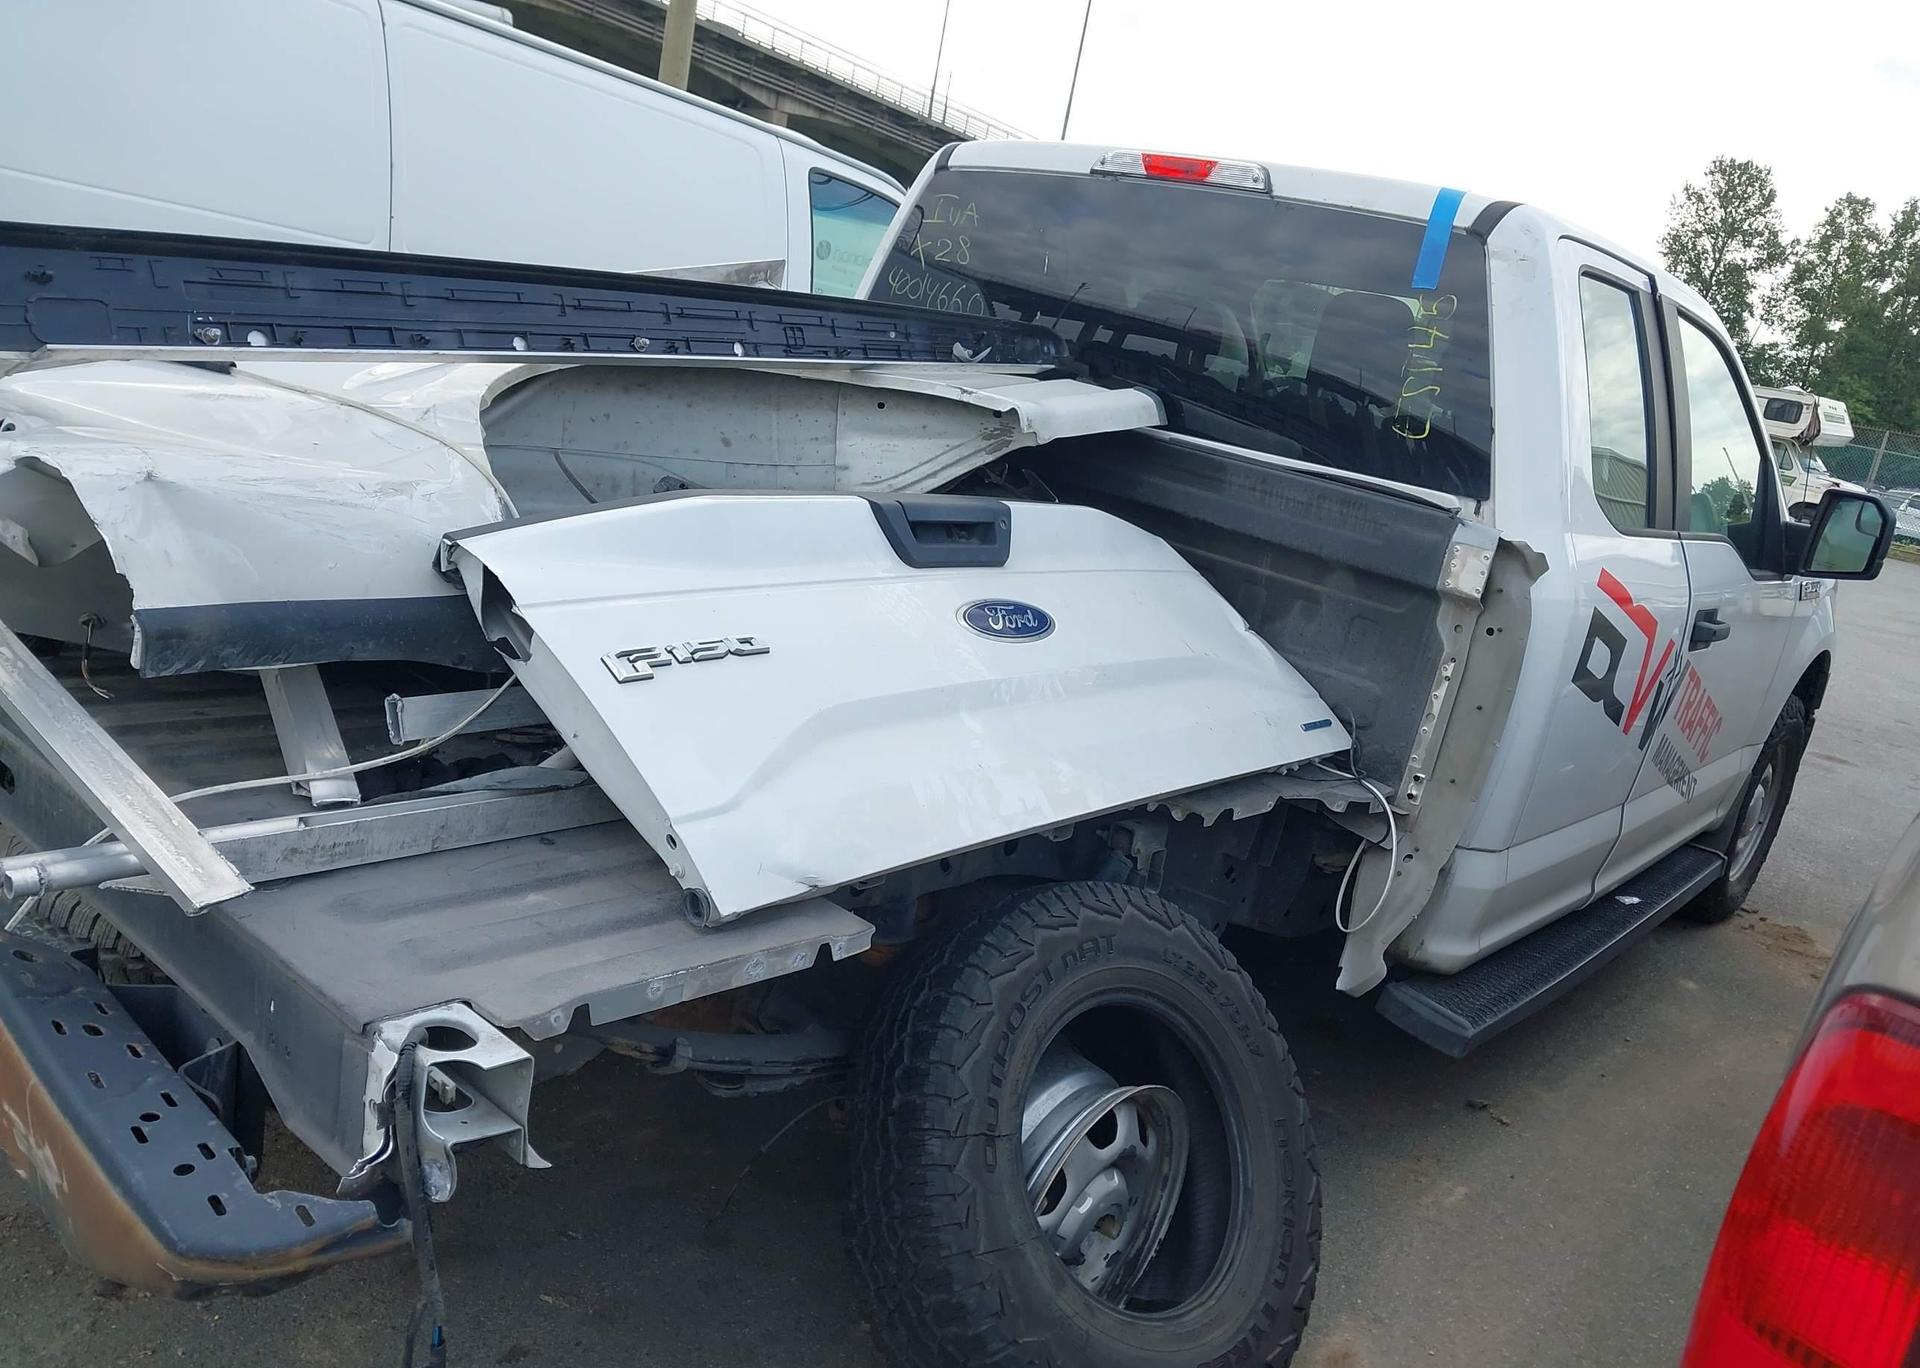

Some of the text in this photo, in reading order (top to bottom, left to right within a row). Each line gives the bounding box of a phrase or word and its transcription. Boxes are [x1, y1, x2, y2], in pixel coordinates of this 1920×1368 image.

[984, 604, 1038, 631] Ford
[1673, 665, 1724, 764] TRAFFIC
[1651, 733, 1699, 804] MANAGEMENT
